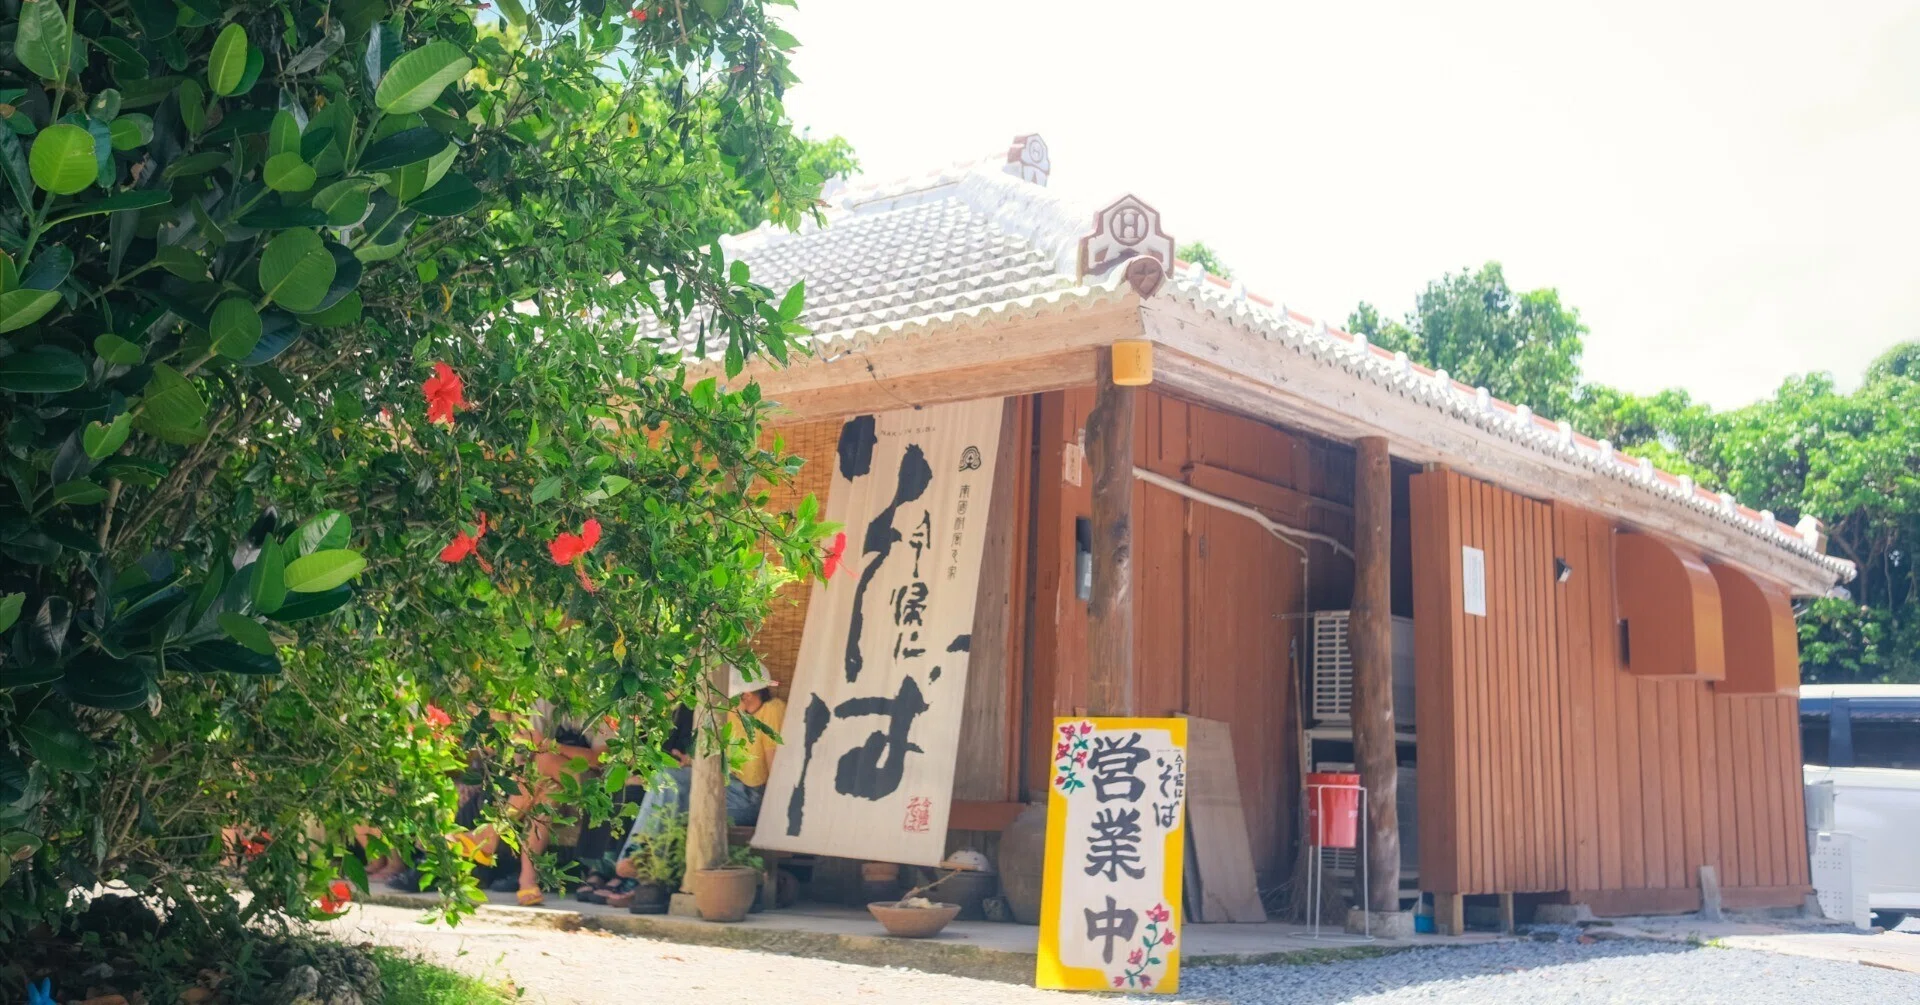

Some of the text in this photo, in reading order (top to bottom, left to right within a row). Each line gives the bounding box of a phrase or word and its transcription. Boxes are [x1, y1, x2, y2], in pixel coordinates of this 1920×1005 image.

[1083, 732, 1151, 964] 営業中
[1152, 757, 1179, 829] そば
